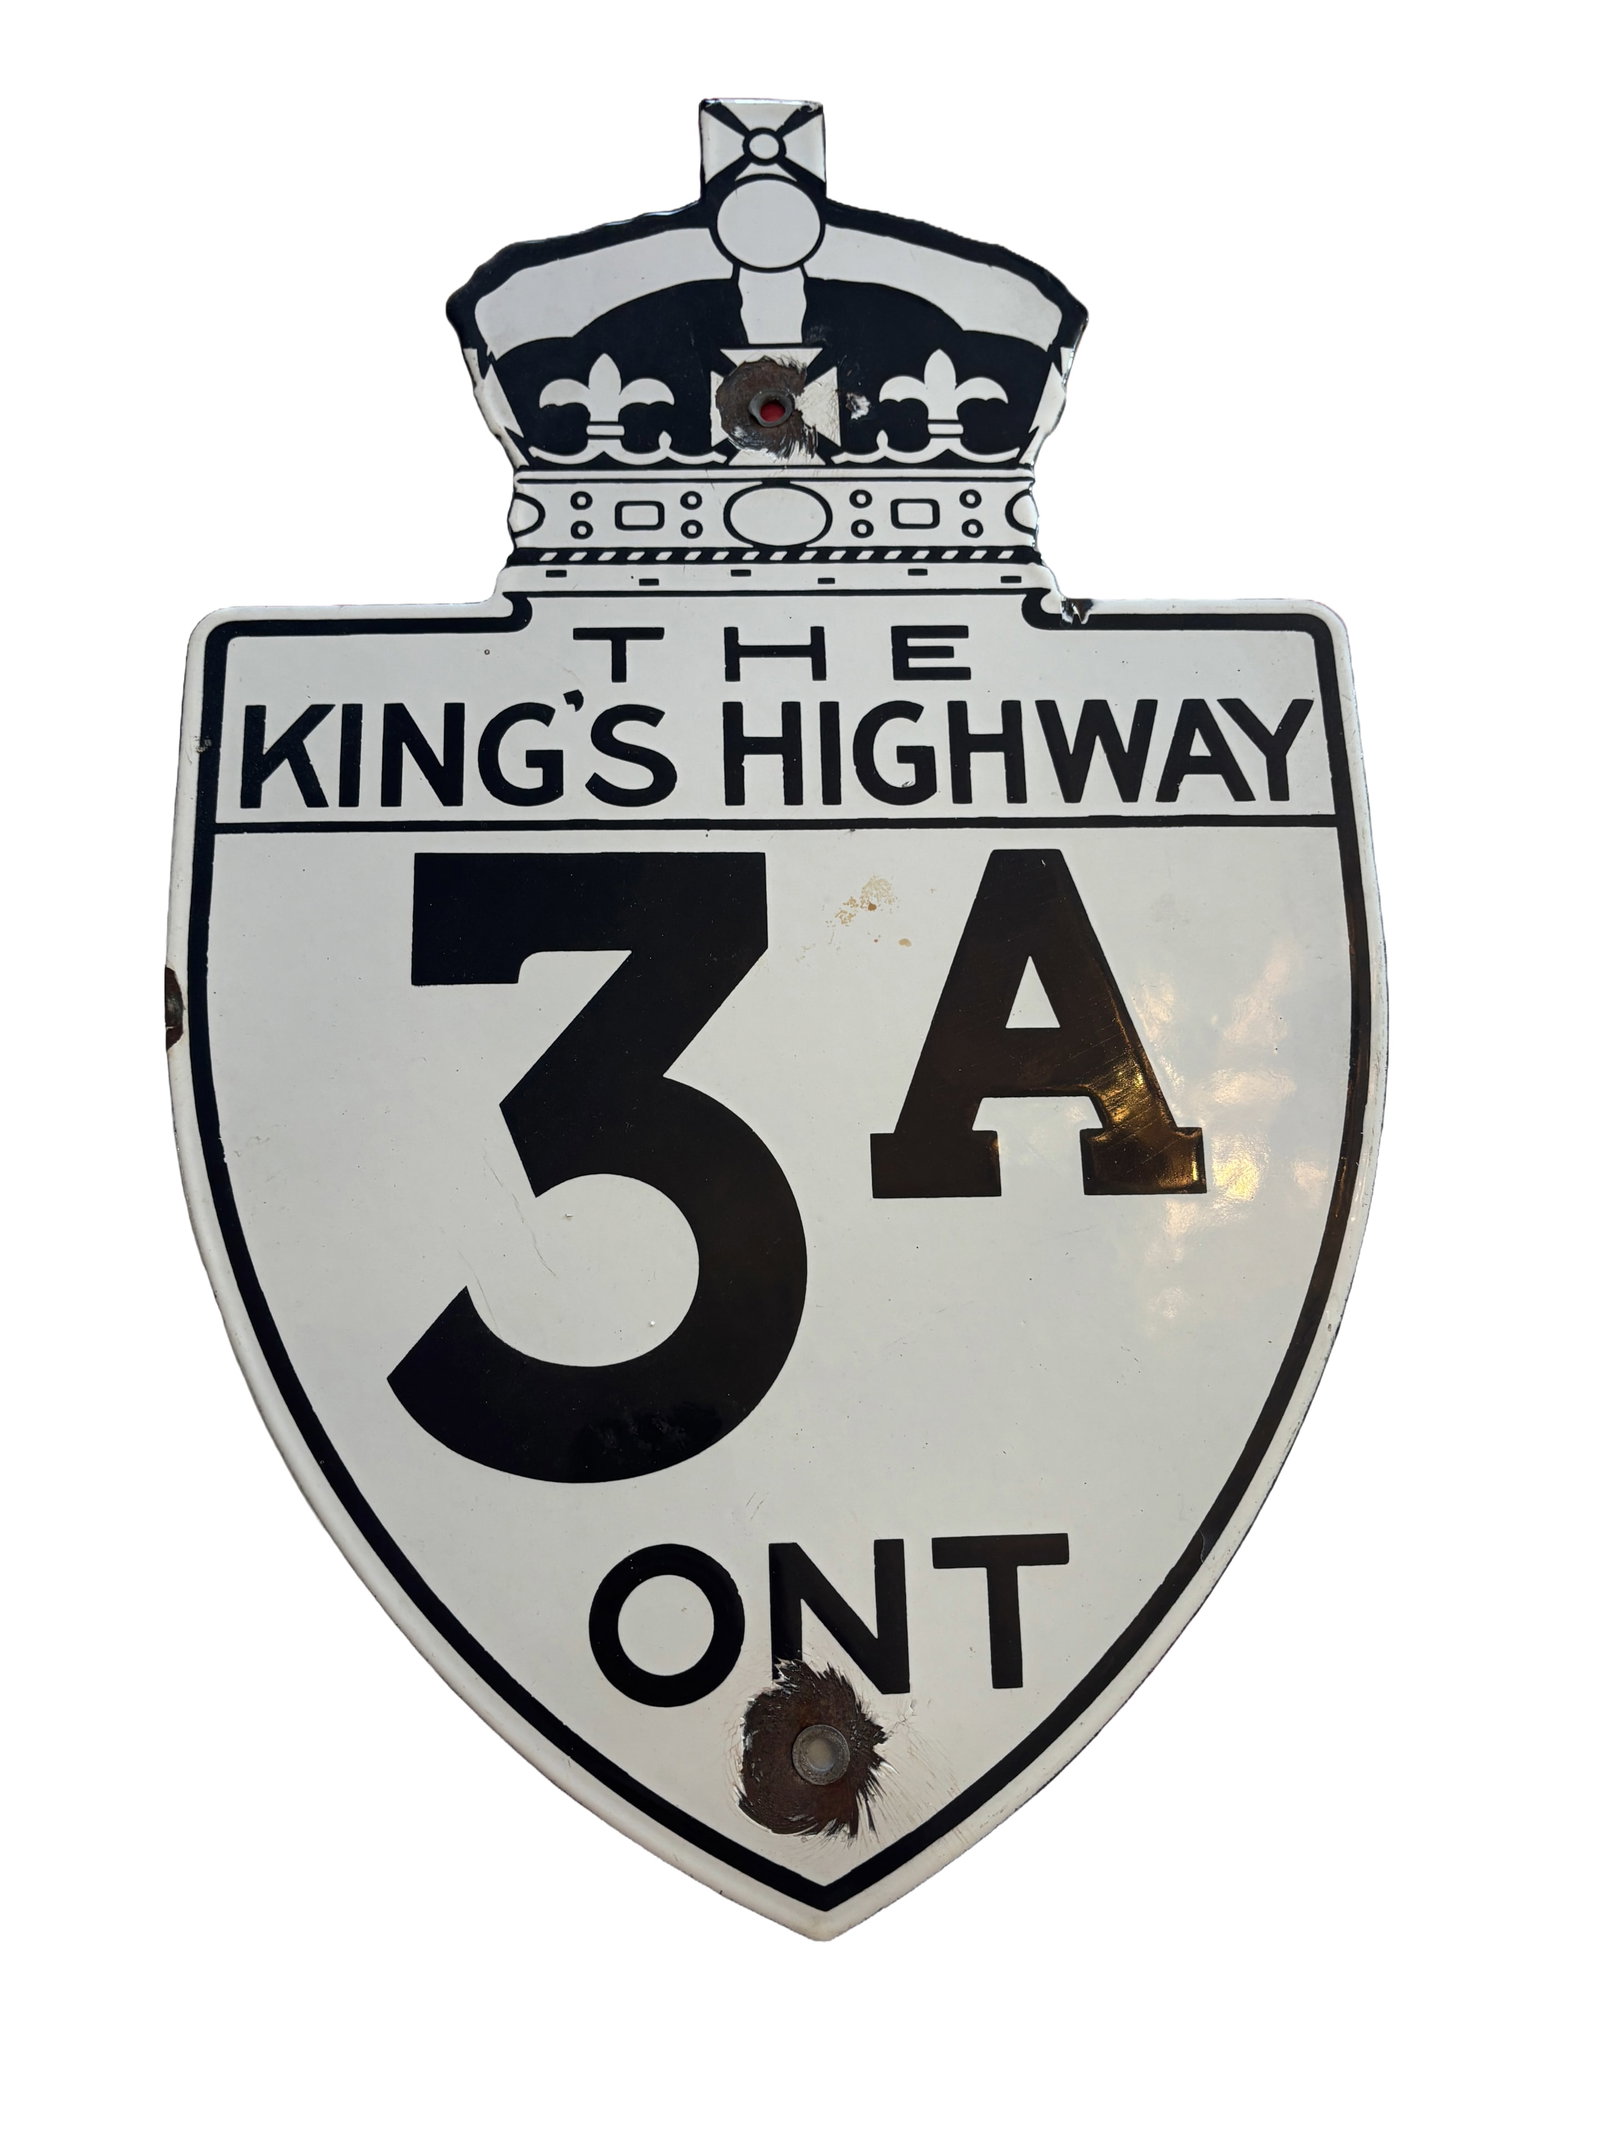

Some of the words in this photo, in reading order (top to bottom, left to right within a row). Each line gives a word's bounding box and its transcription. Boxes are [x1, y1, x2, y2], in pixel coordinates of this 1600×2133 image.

[573, 625, 972, 683] THE
[240, 690, 677, 808] KING'S
[723, 697, 1315, 807] HIGHWAY
[588, 1532, 1070, 1708] ONT
